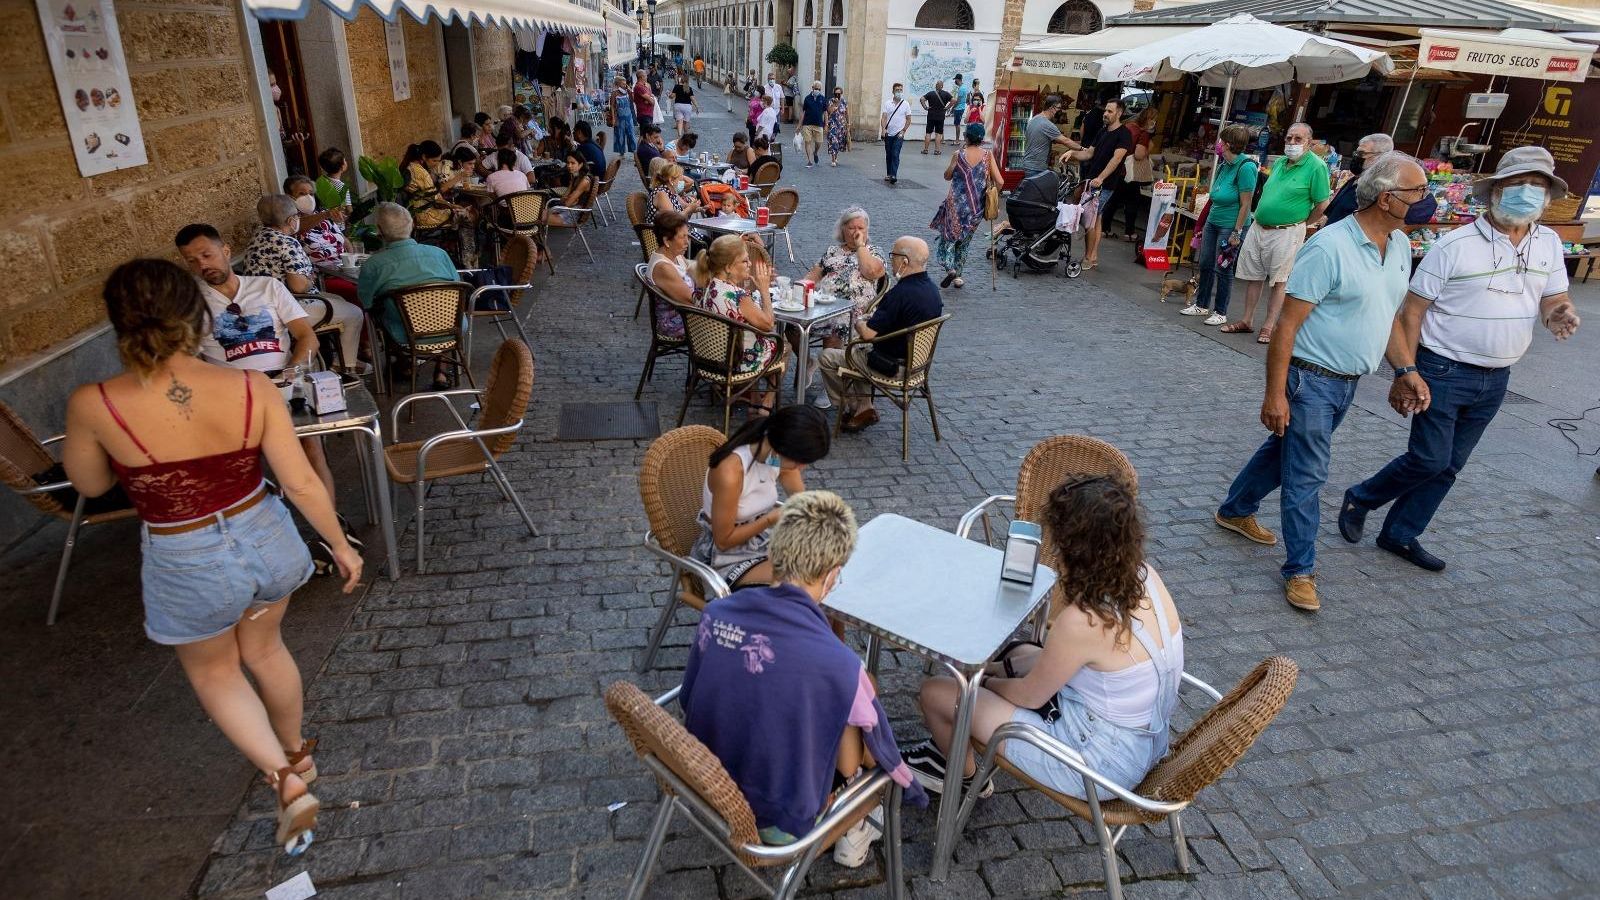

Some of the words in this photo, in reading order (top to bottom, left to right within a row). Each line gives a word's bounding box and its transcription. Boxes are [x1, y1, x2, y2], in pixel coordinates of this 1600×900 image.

[1466, 51, 1506, 65] FRUTOS
[1509, 55, 1541, 68] SECOS
[1530, 118, 1570, 128] TABACOS
[227, 344, 248, 358] BAY
[249, 341, 275, 351] LIFE
